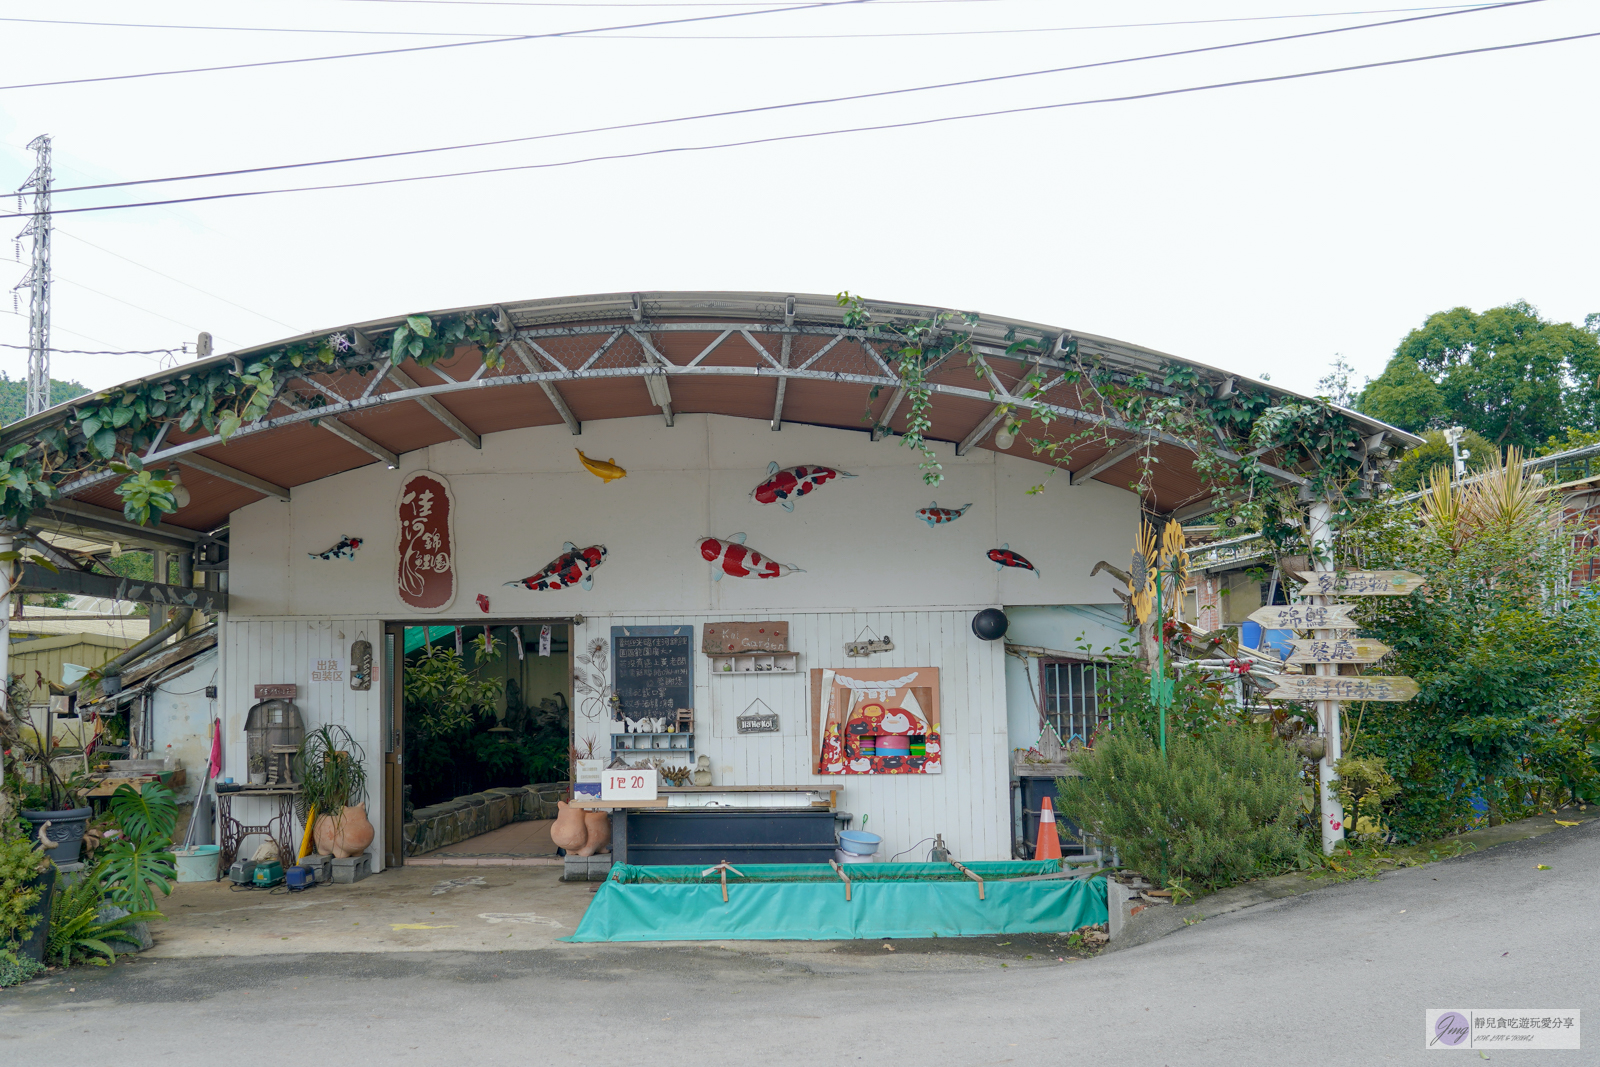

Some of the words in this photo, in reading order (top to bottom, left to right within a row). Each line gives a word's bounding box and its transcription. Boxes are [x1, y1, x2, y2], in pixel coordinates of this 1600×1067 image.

[1278, 607, 1329, 629] 錦鯉
[722, 629, 740, 640] Koi
[741, 637, 784, 651] Garden
[1310, 640, 1355, 662] 餐廳
[317, 660, 338, 671] 出货
[312, 670, 344, 682] 包装区
[1319, 679, 1393, 700] 手作教室
[630, 775, 645, 789] 20
